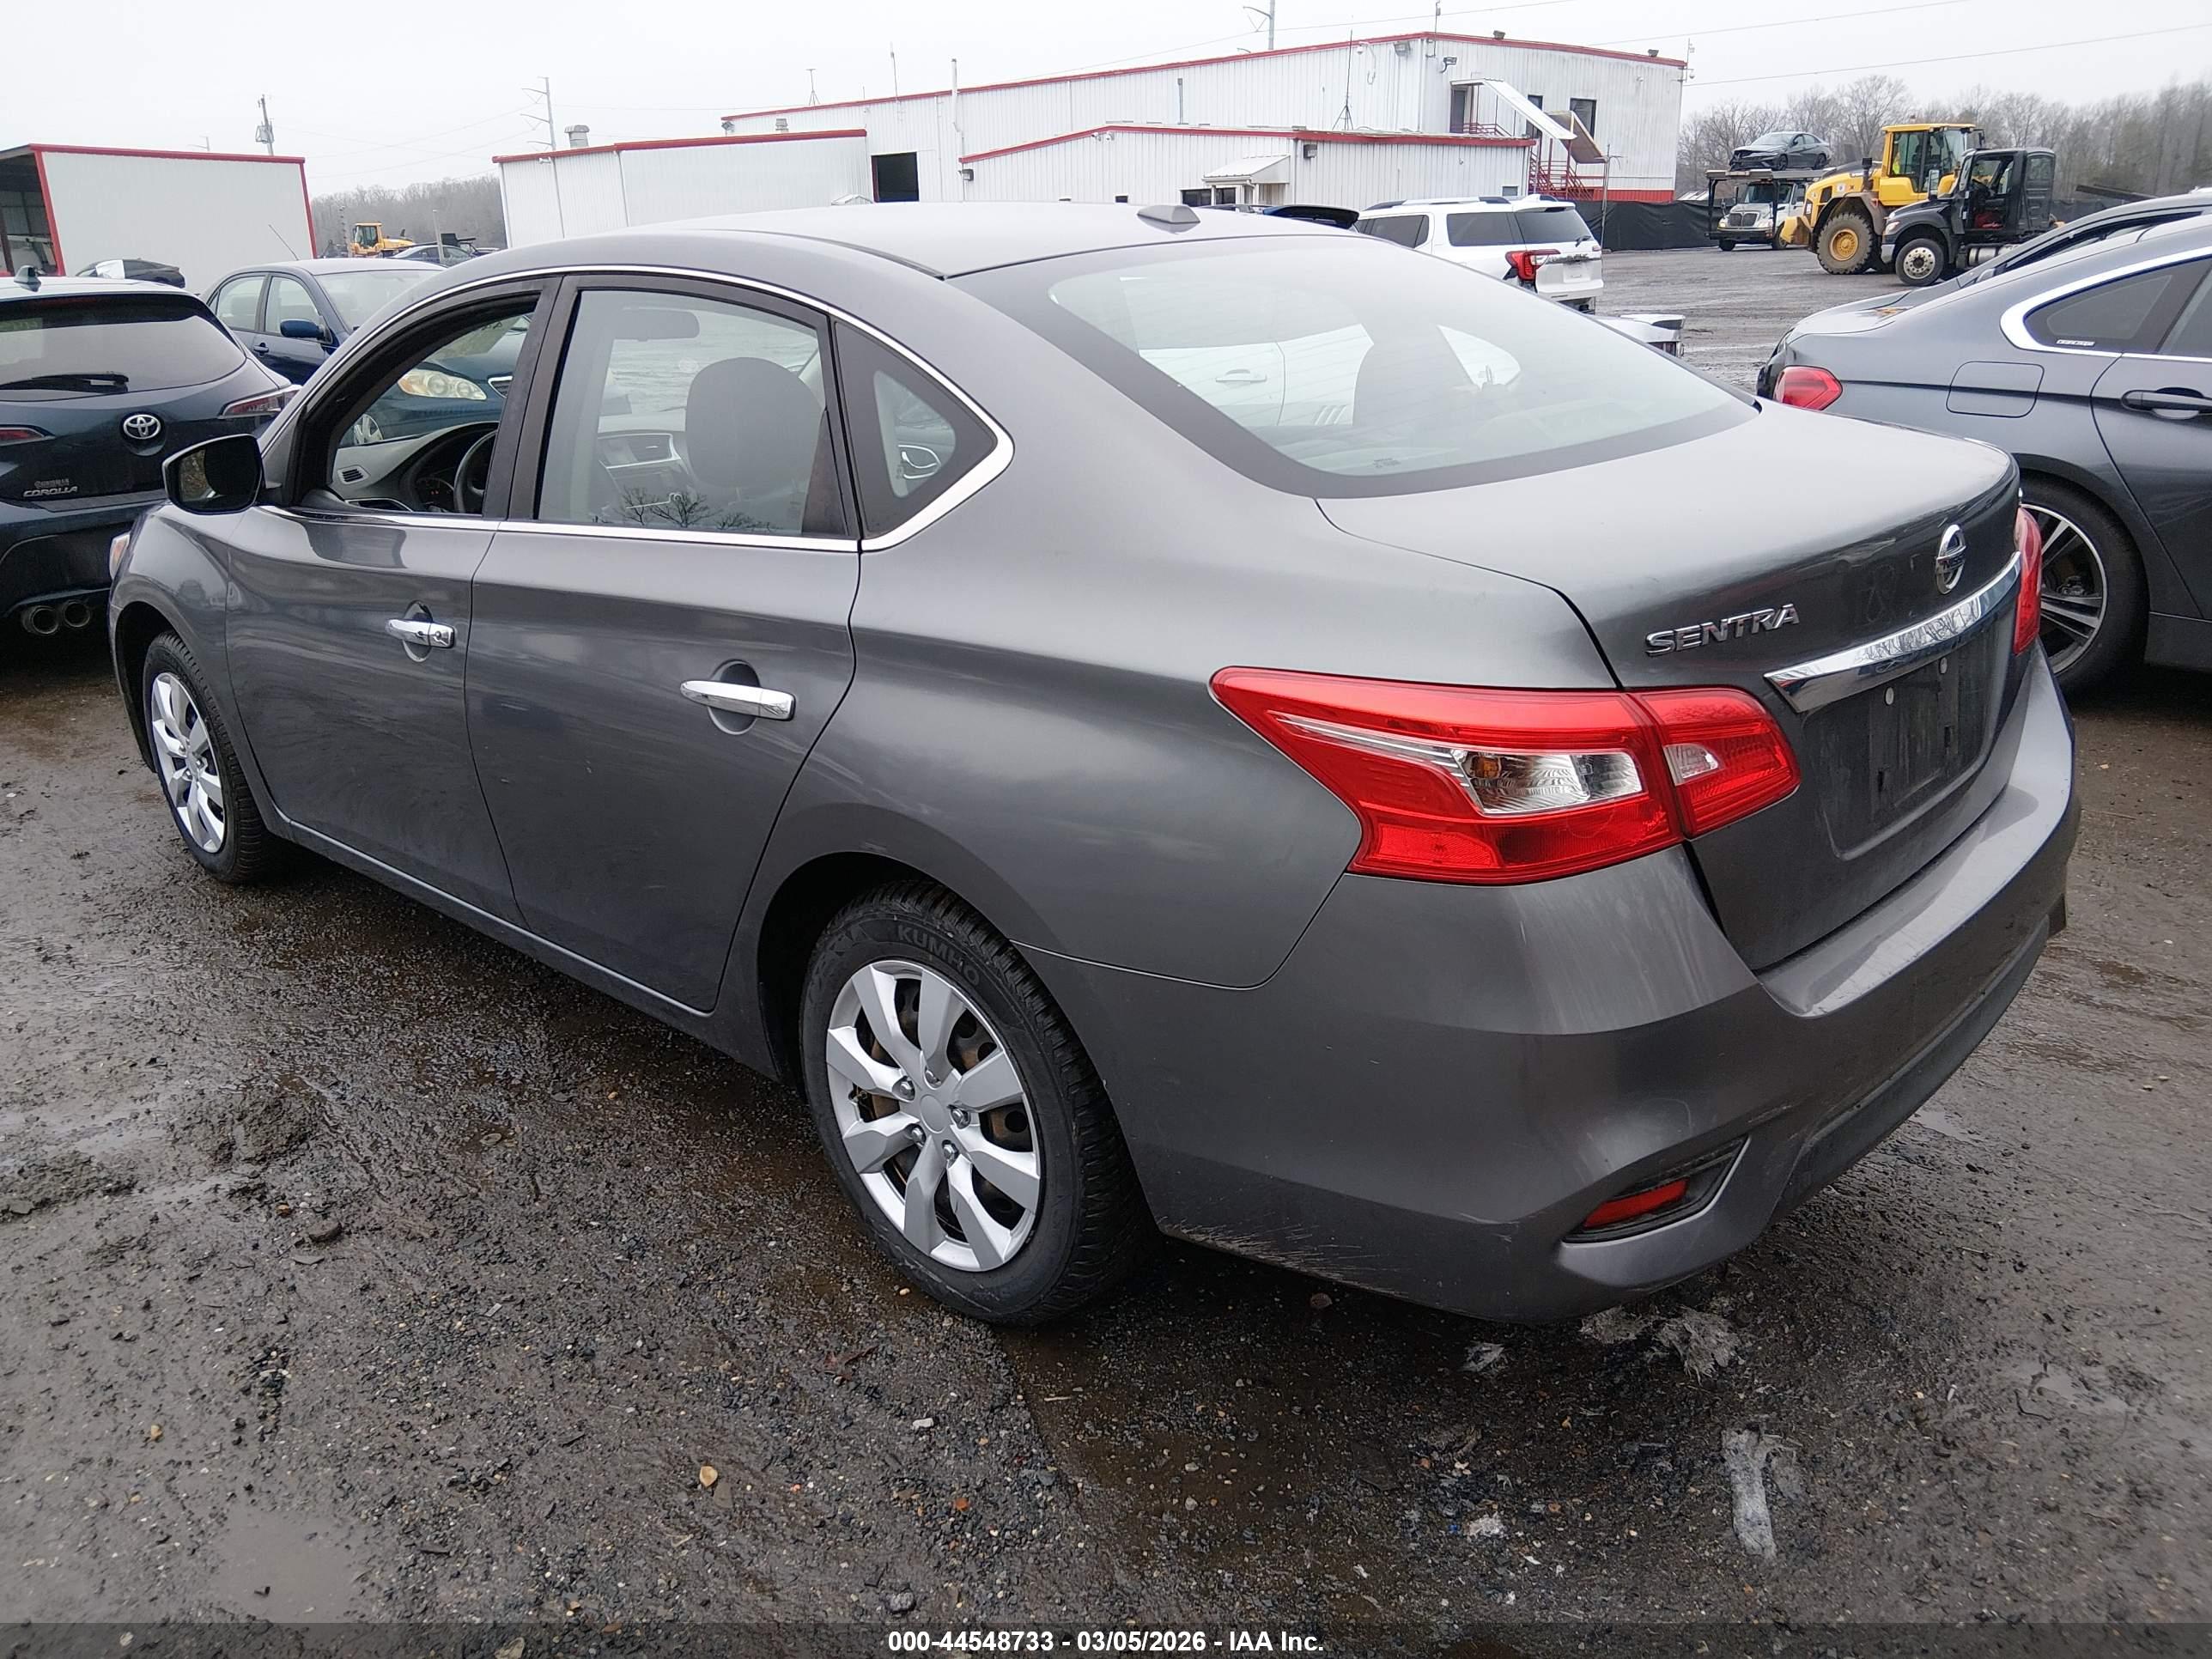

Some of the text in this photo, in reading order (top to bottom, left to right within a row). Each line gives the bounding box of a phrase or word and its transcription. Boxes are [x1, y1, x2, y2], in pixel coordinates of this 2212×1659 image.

[23, 486, 78, 497] COROLLA
[1645, 604, 1800, 656] SENTRA
[898, 926, 980, 986] KUMHO
